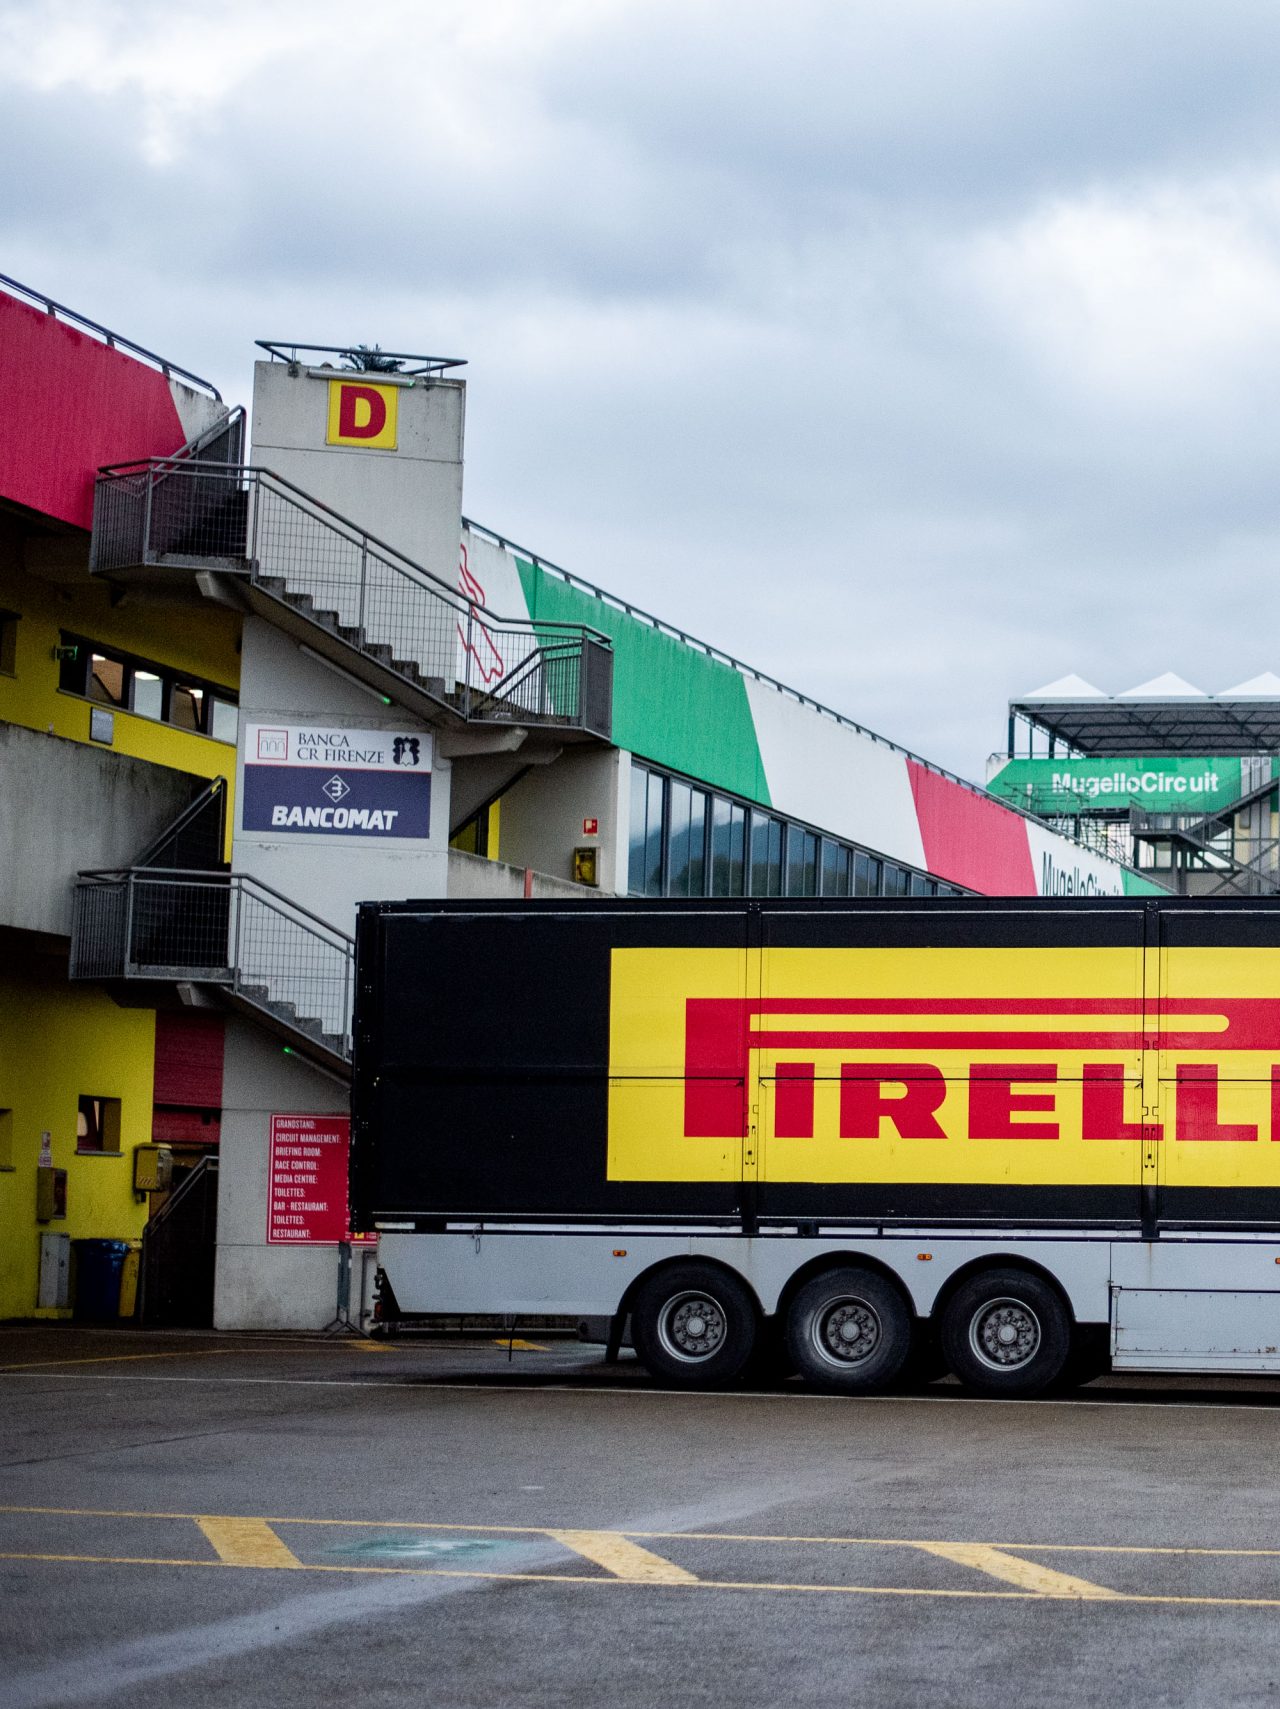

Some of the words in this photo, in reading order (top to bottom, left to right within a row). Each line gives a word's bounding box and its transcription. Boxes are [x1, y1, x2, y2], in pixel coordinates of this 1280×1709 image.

[339, 385, 387, 438] D
[298, 733, 350, 747] BANCA
[297, 748, 318, 760] CR
[325, 749, 385, 764] FIRENZE
[271, 805, 398, 830] BANCOMAT
[276, 1120, 316, 1129] GRANDSTAND:
[275, 1133, 299, 1142] CIRCUIT
[300, 1134, 341, 1143] MANAGEMENT:
[275, 1147, 302, 1156] BRIEFING
[303, 1148, 322, 1156] ROOM:
[275, 1160, 289, 1169] RACE
[291, 1161, 319, 1170] CONTROL:
[274, 1174, 293, 1183] MEDIA
[294, 1175, 317, 1184] CENTRE:
[274, 1188, 305, 1197] TOILETTES:
[273, 1202, 285, 1210] BAR
[290, 1202, 328, 1211] RESTAURANT:
[273, 1215, 305, 1224] TOILETTES:
[272, 1229, 311, 1238] RESTAURANT:
